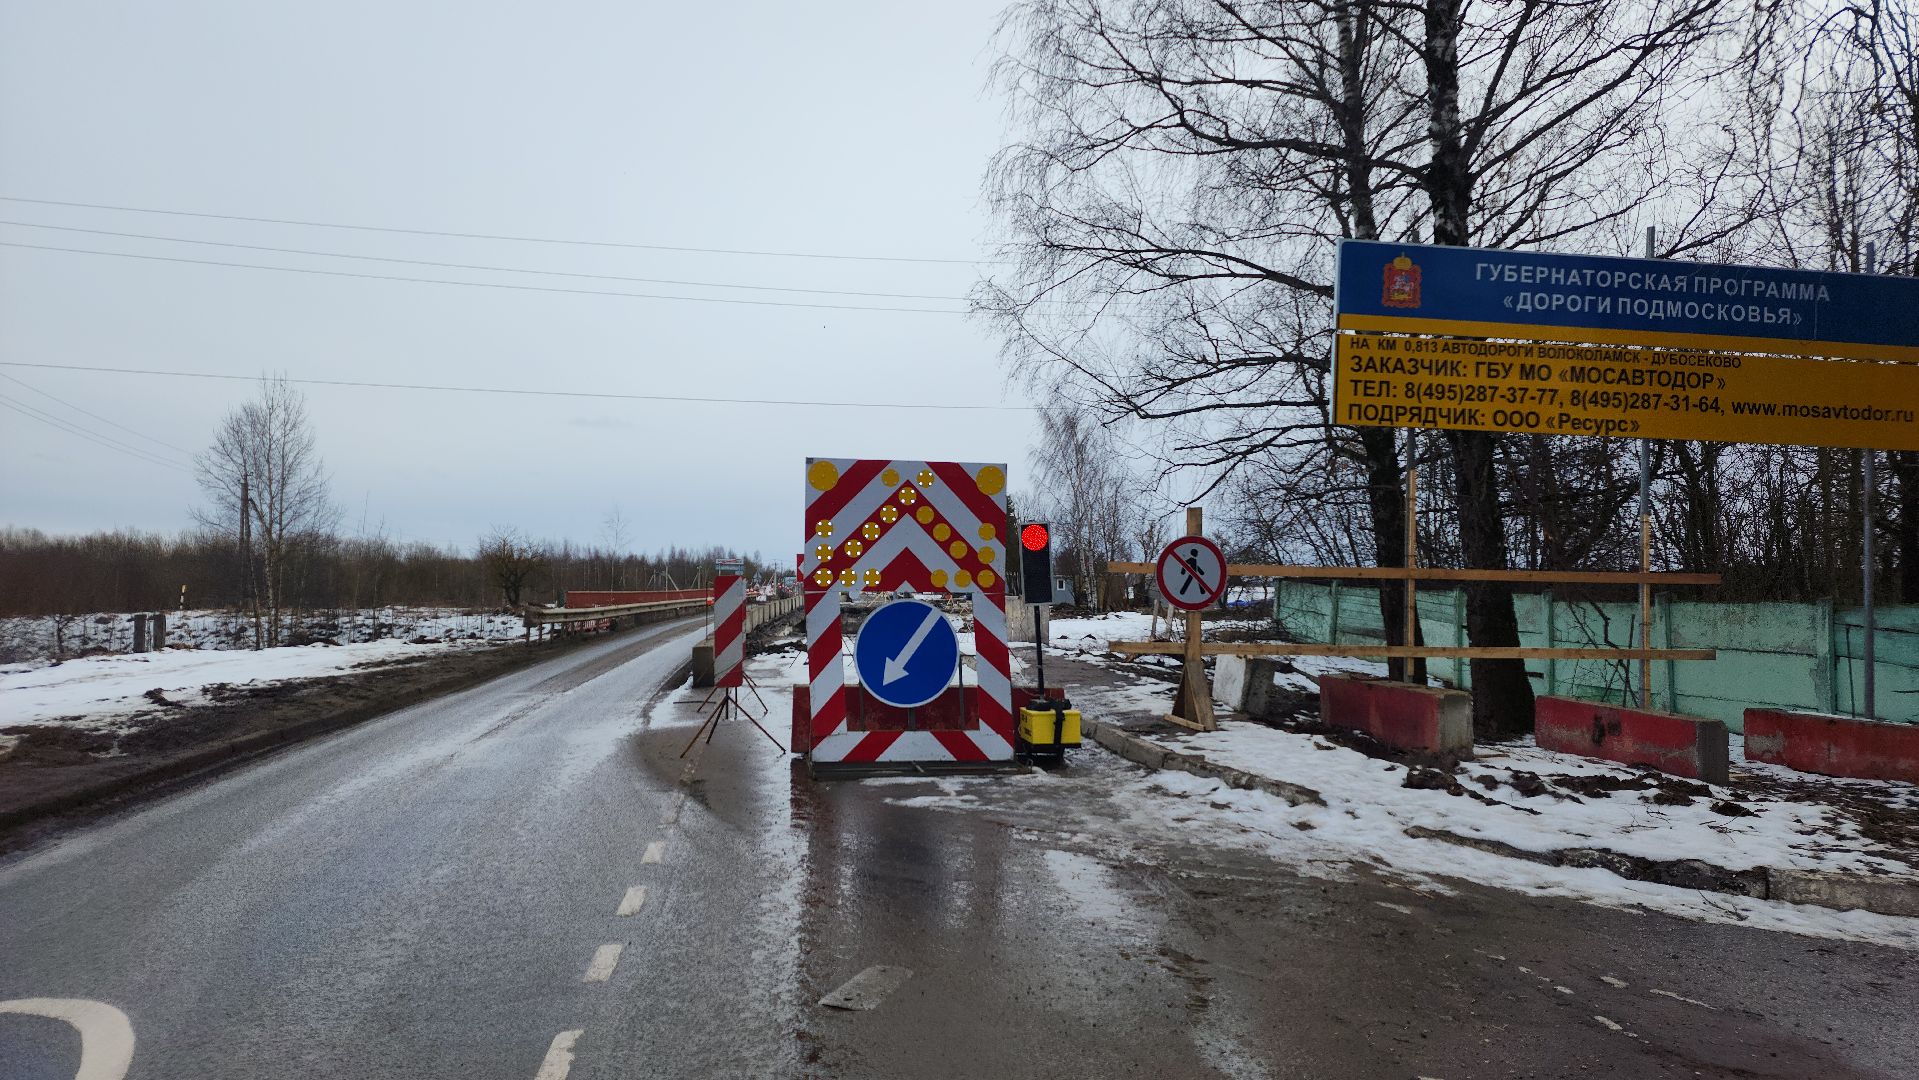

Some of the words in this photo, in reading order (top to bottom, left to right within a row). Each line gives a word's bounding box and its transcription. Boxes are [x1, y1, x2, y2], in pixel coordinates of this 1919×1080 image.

[1475, 263, 1688, 293] ГУБЕРНАТОРСКАЯ
[1693, 276, 1830, 302] ПРОГРАММА
[1503, 292, 1611, 314] «ДОРОГИ
[1617, 298, 1803, 326] ПОДМОСКОВЬЯ»
[1350, 338, 1369, 350] НА
[1377, 339, 1397, 351] КМ
[1440, 342, 1534, 359] АВТОДОРОГИ
[1651, 354, 1742, 368] ДУБОСЕКОВО
[1350, 355, 1468, 378] ЗАКАЗЧИК:
[1475, 361, 1513, 379] ГБУ
[1519, 364, 1552, 381] МО
[1350, 379, 1398, 398] ТЕЛ:
[1404, 382, 1565, 408] 8(495)287-37-77,
[1570, 391, 1725, 416] 8(495)287-31-64,
[1731, 400, 1914, 424] www.mosavtodor.ru
[1348, 403, 1486, 426] ПОДРЯДЧИК:
[1492, 410, 1541, 428] ООО
[1545, 413, 1641, 436] «Ресурс»
